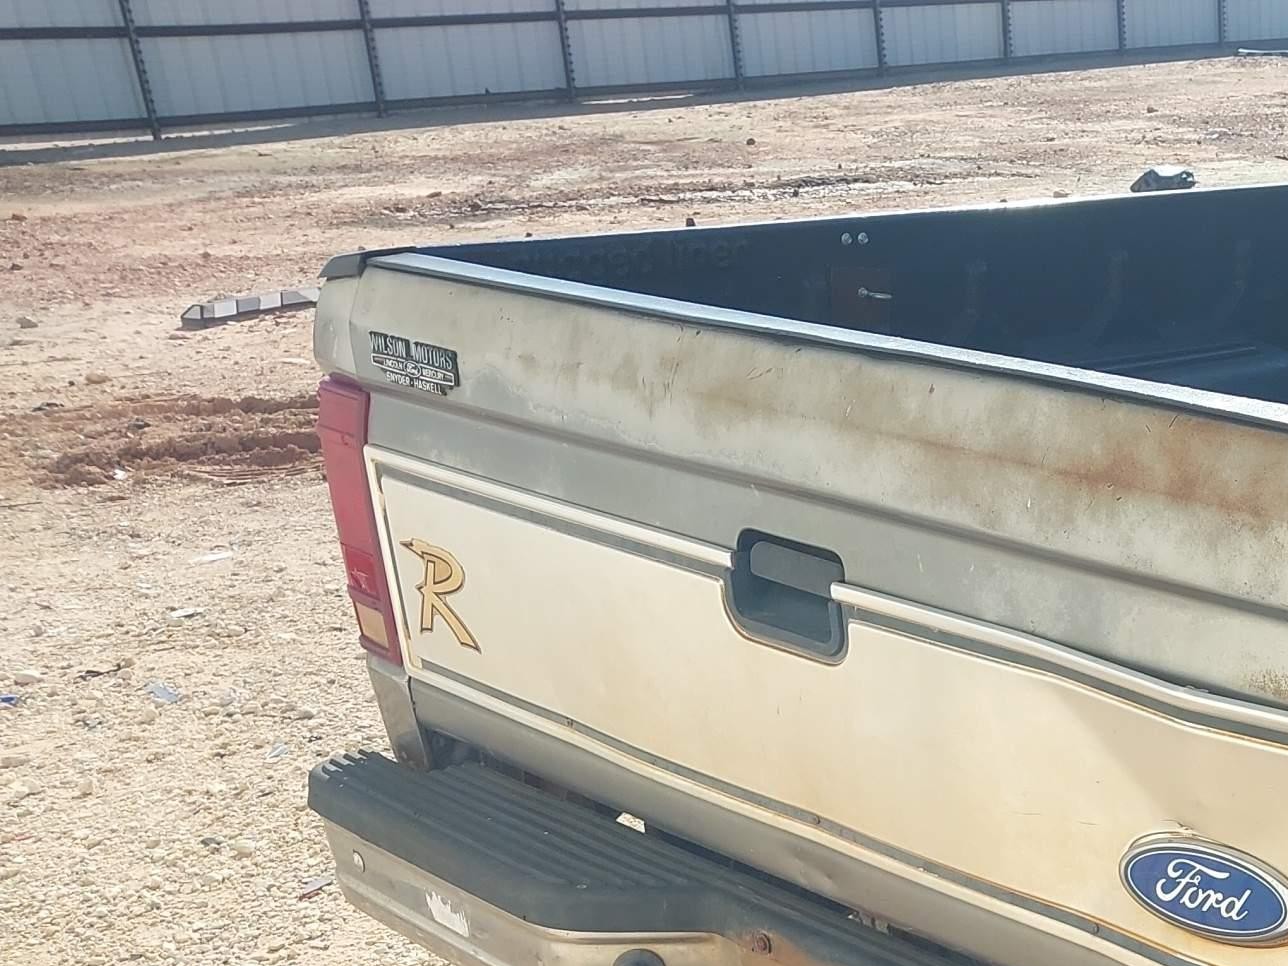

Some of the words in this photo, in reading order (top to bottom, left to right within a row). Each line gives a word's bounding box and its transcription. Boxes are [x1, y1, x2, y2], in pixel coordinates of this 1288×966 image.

[369, 333, 407, 359] WILSON
[412, 343, 454, 370] MOTORS
[1155, 858, 1252, 921] Ford
